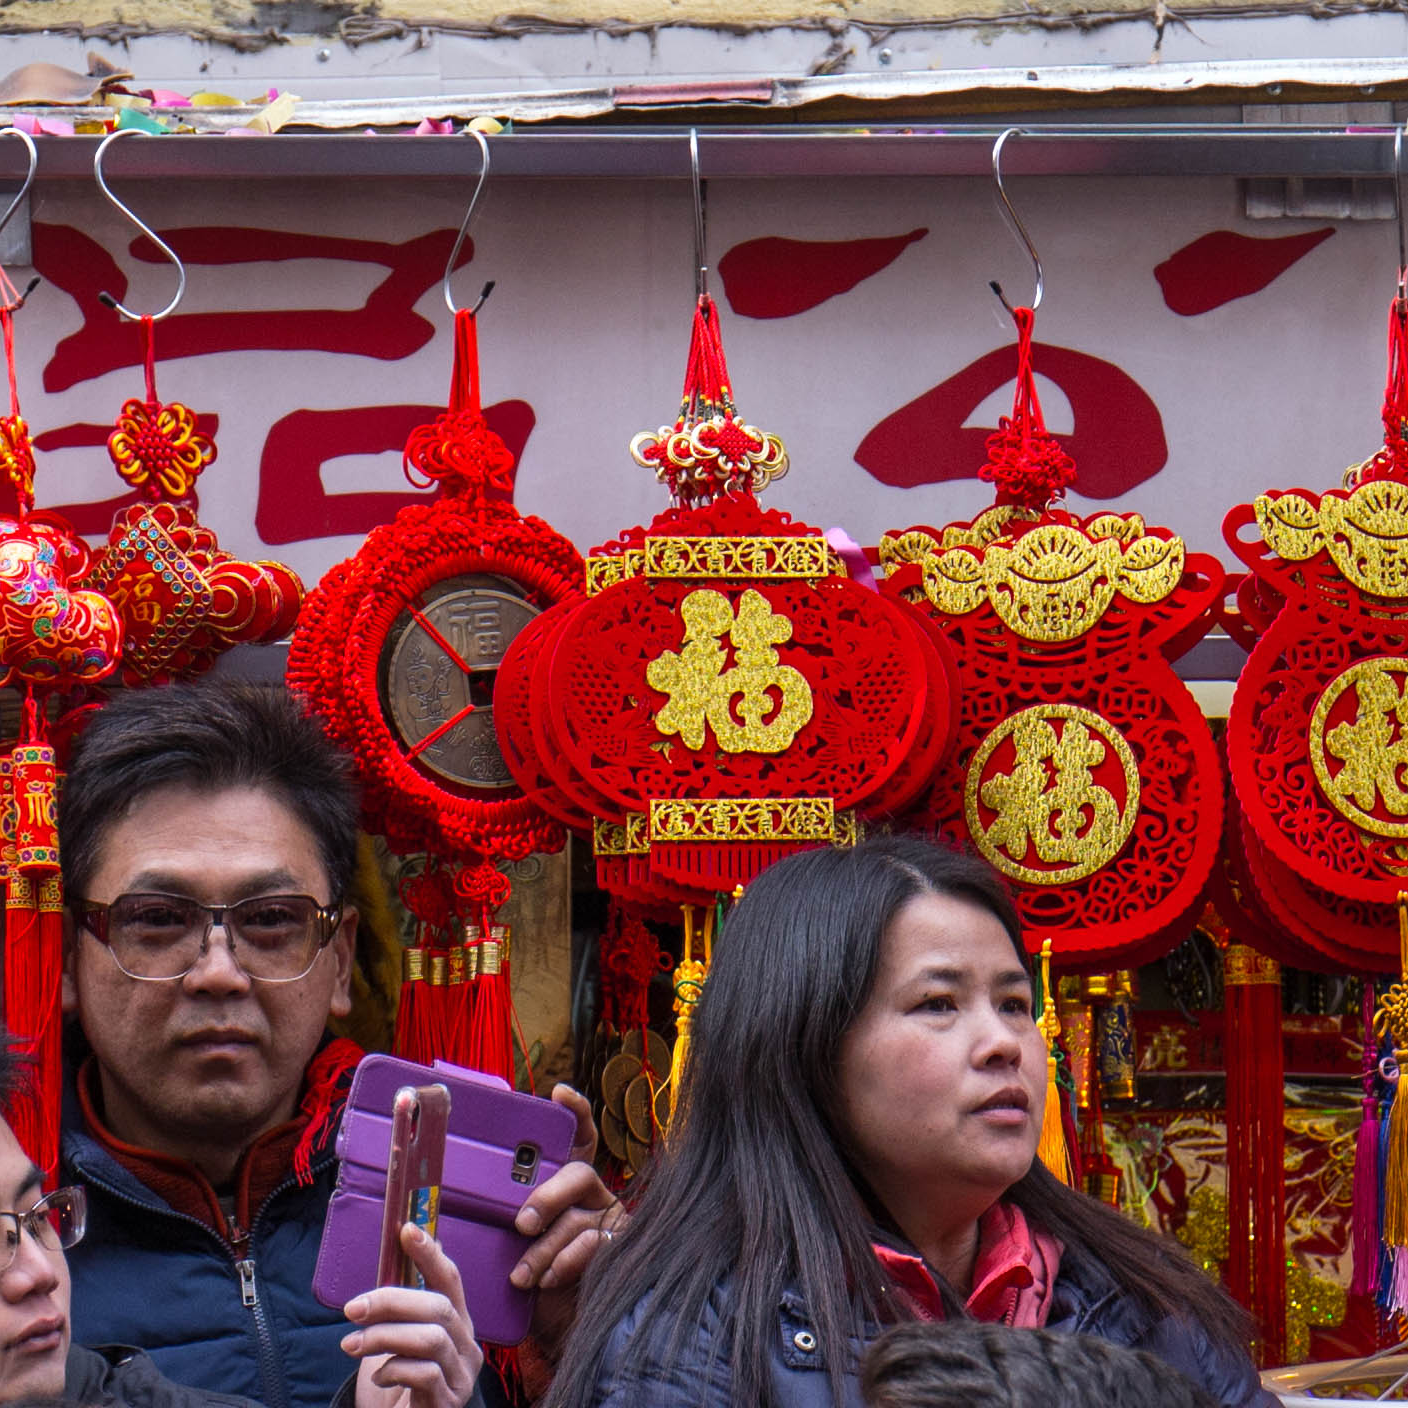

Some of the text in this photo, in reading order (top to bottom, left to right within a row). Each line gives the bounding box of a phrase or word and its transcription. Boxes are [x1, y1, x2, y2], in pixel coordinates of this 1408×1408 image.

[655, 540, 821, 574] 富貴有餘
[109, 572, 163, 626] 福
[447, 600, 502, 660] 福
[646, 588, 814, 754] 福
[980, 717, 1122, 866] 福
